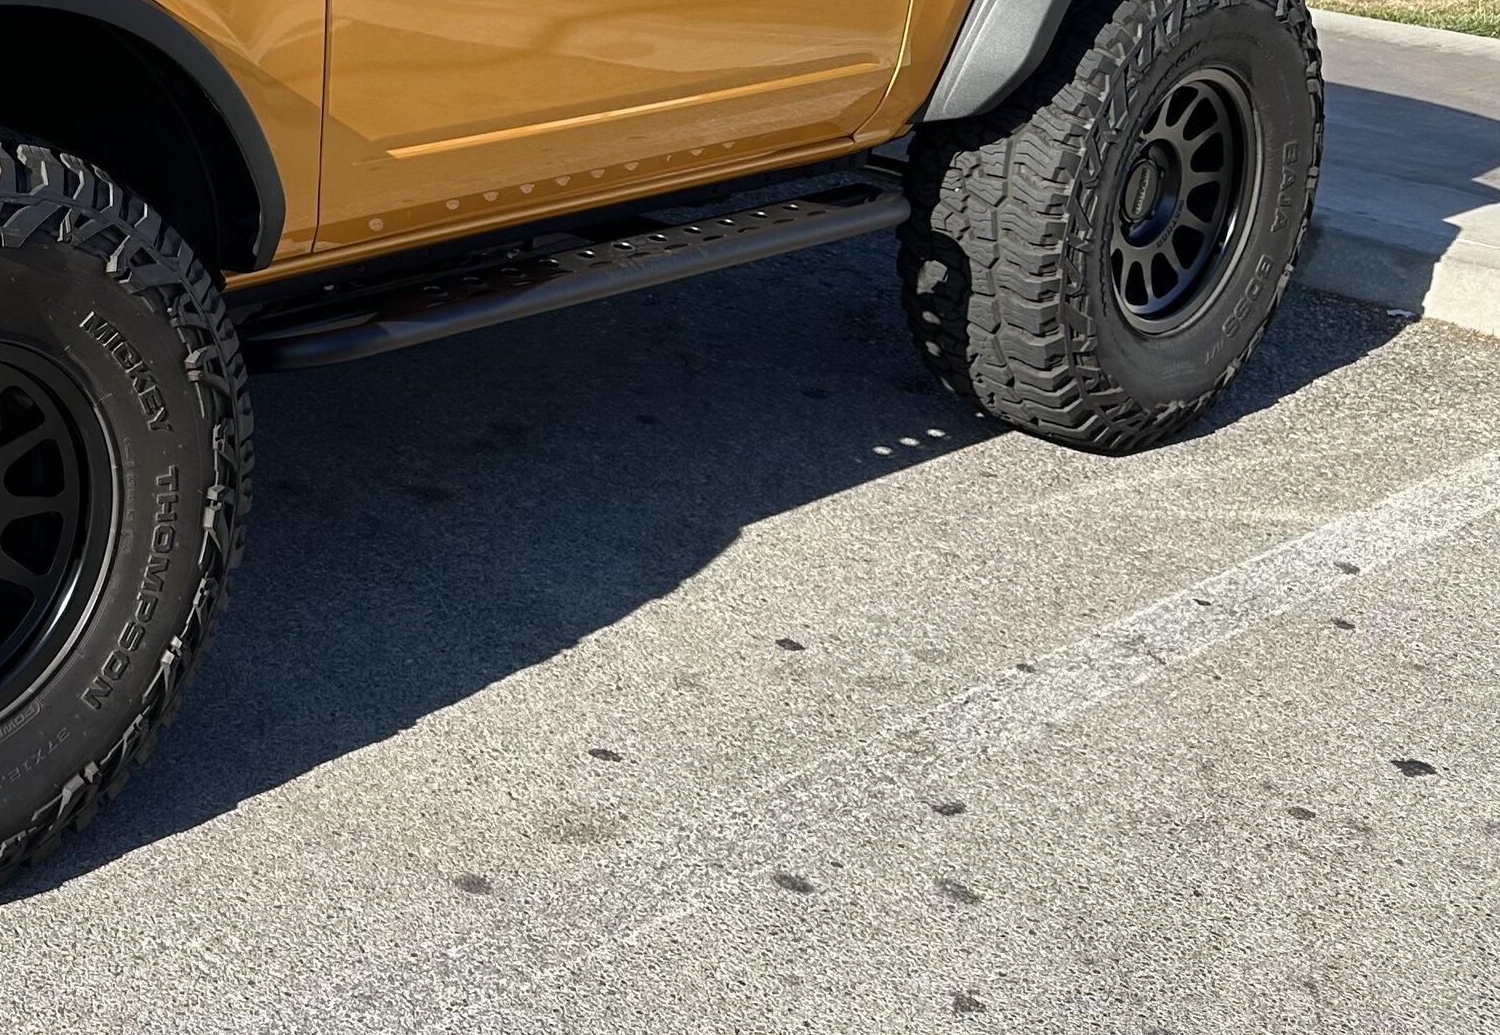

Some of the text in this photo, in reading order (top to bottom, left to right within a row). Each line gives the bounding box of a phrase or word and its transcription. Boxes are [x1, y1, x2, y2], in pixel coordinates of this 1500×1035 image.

[1221, 142, 1299, 338] BAJA BOSS
[78, 309, 181, 711] MICKEY THOMPSON
